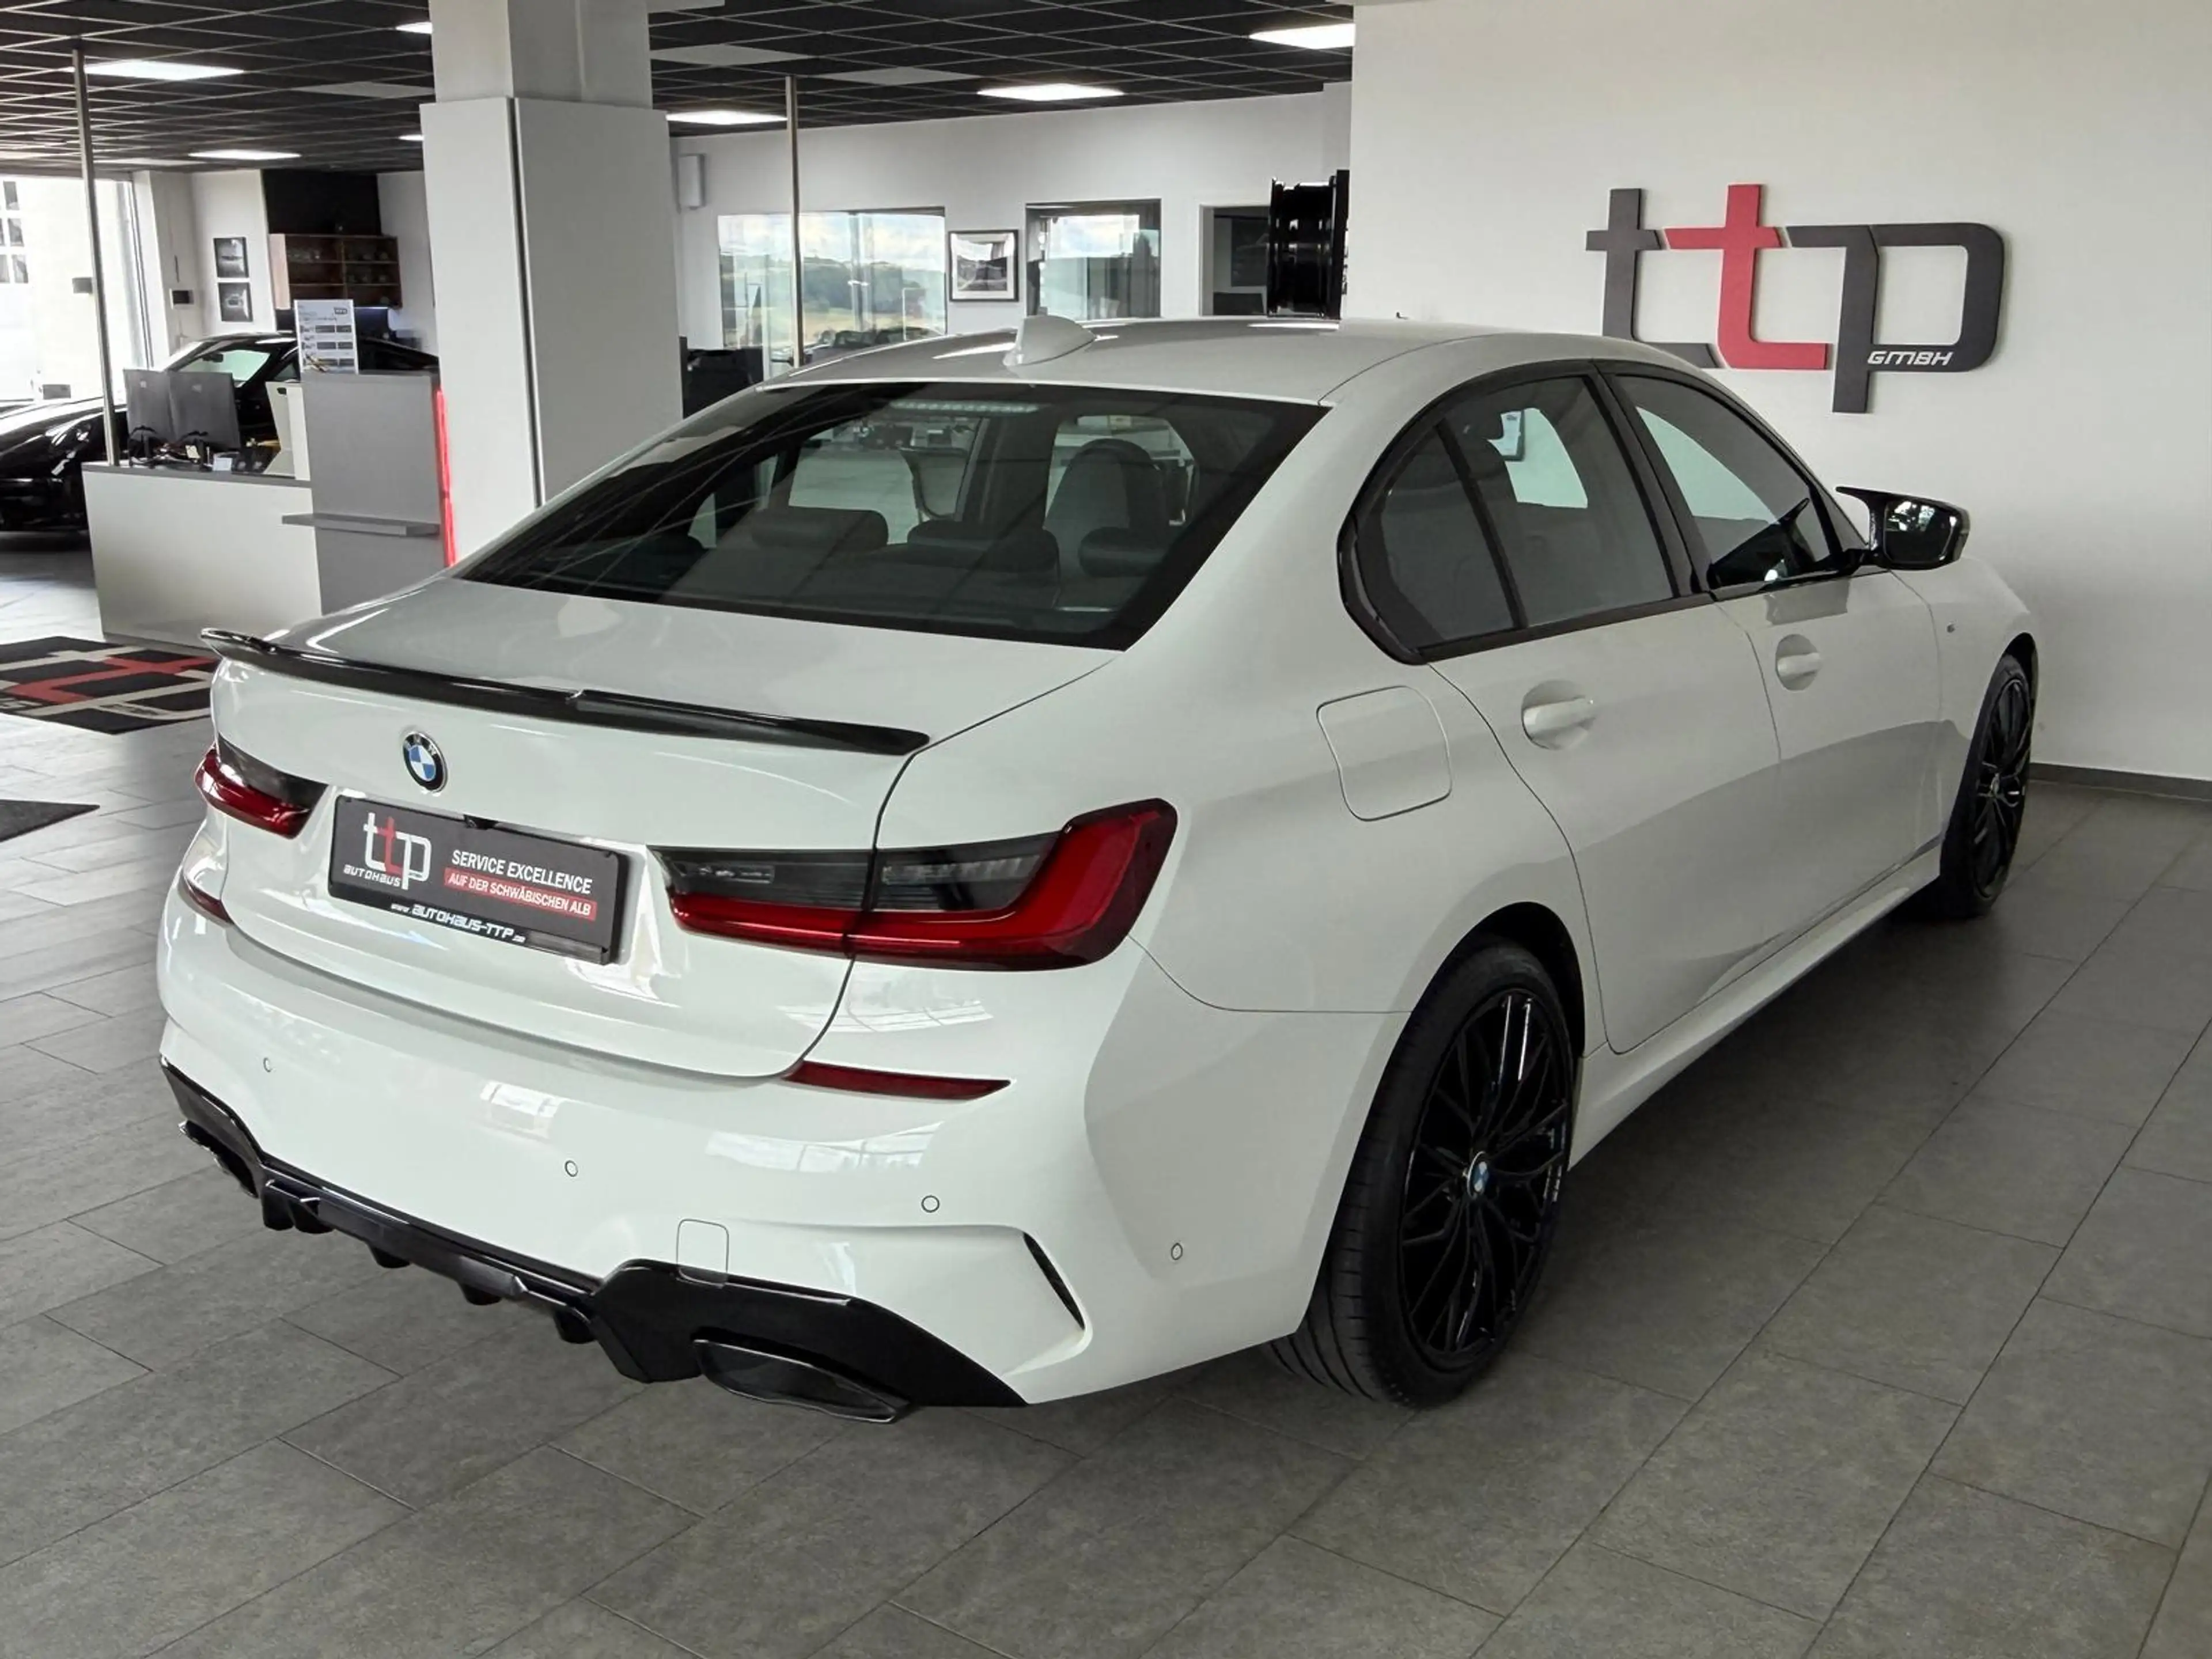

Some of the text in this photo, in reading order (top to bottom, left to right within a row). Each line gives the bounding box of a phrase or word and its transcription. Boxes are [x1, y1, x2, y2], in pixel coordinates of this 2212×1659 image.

[1585, 183, 2005, 413] ttp
[448, 872, 592, 916] AUF DER SCHWÄBISCHEN ALB
[452, 850, 593, 895] SERVICE EXCELLENCE
